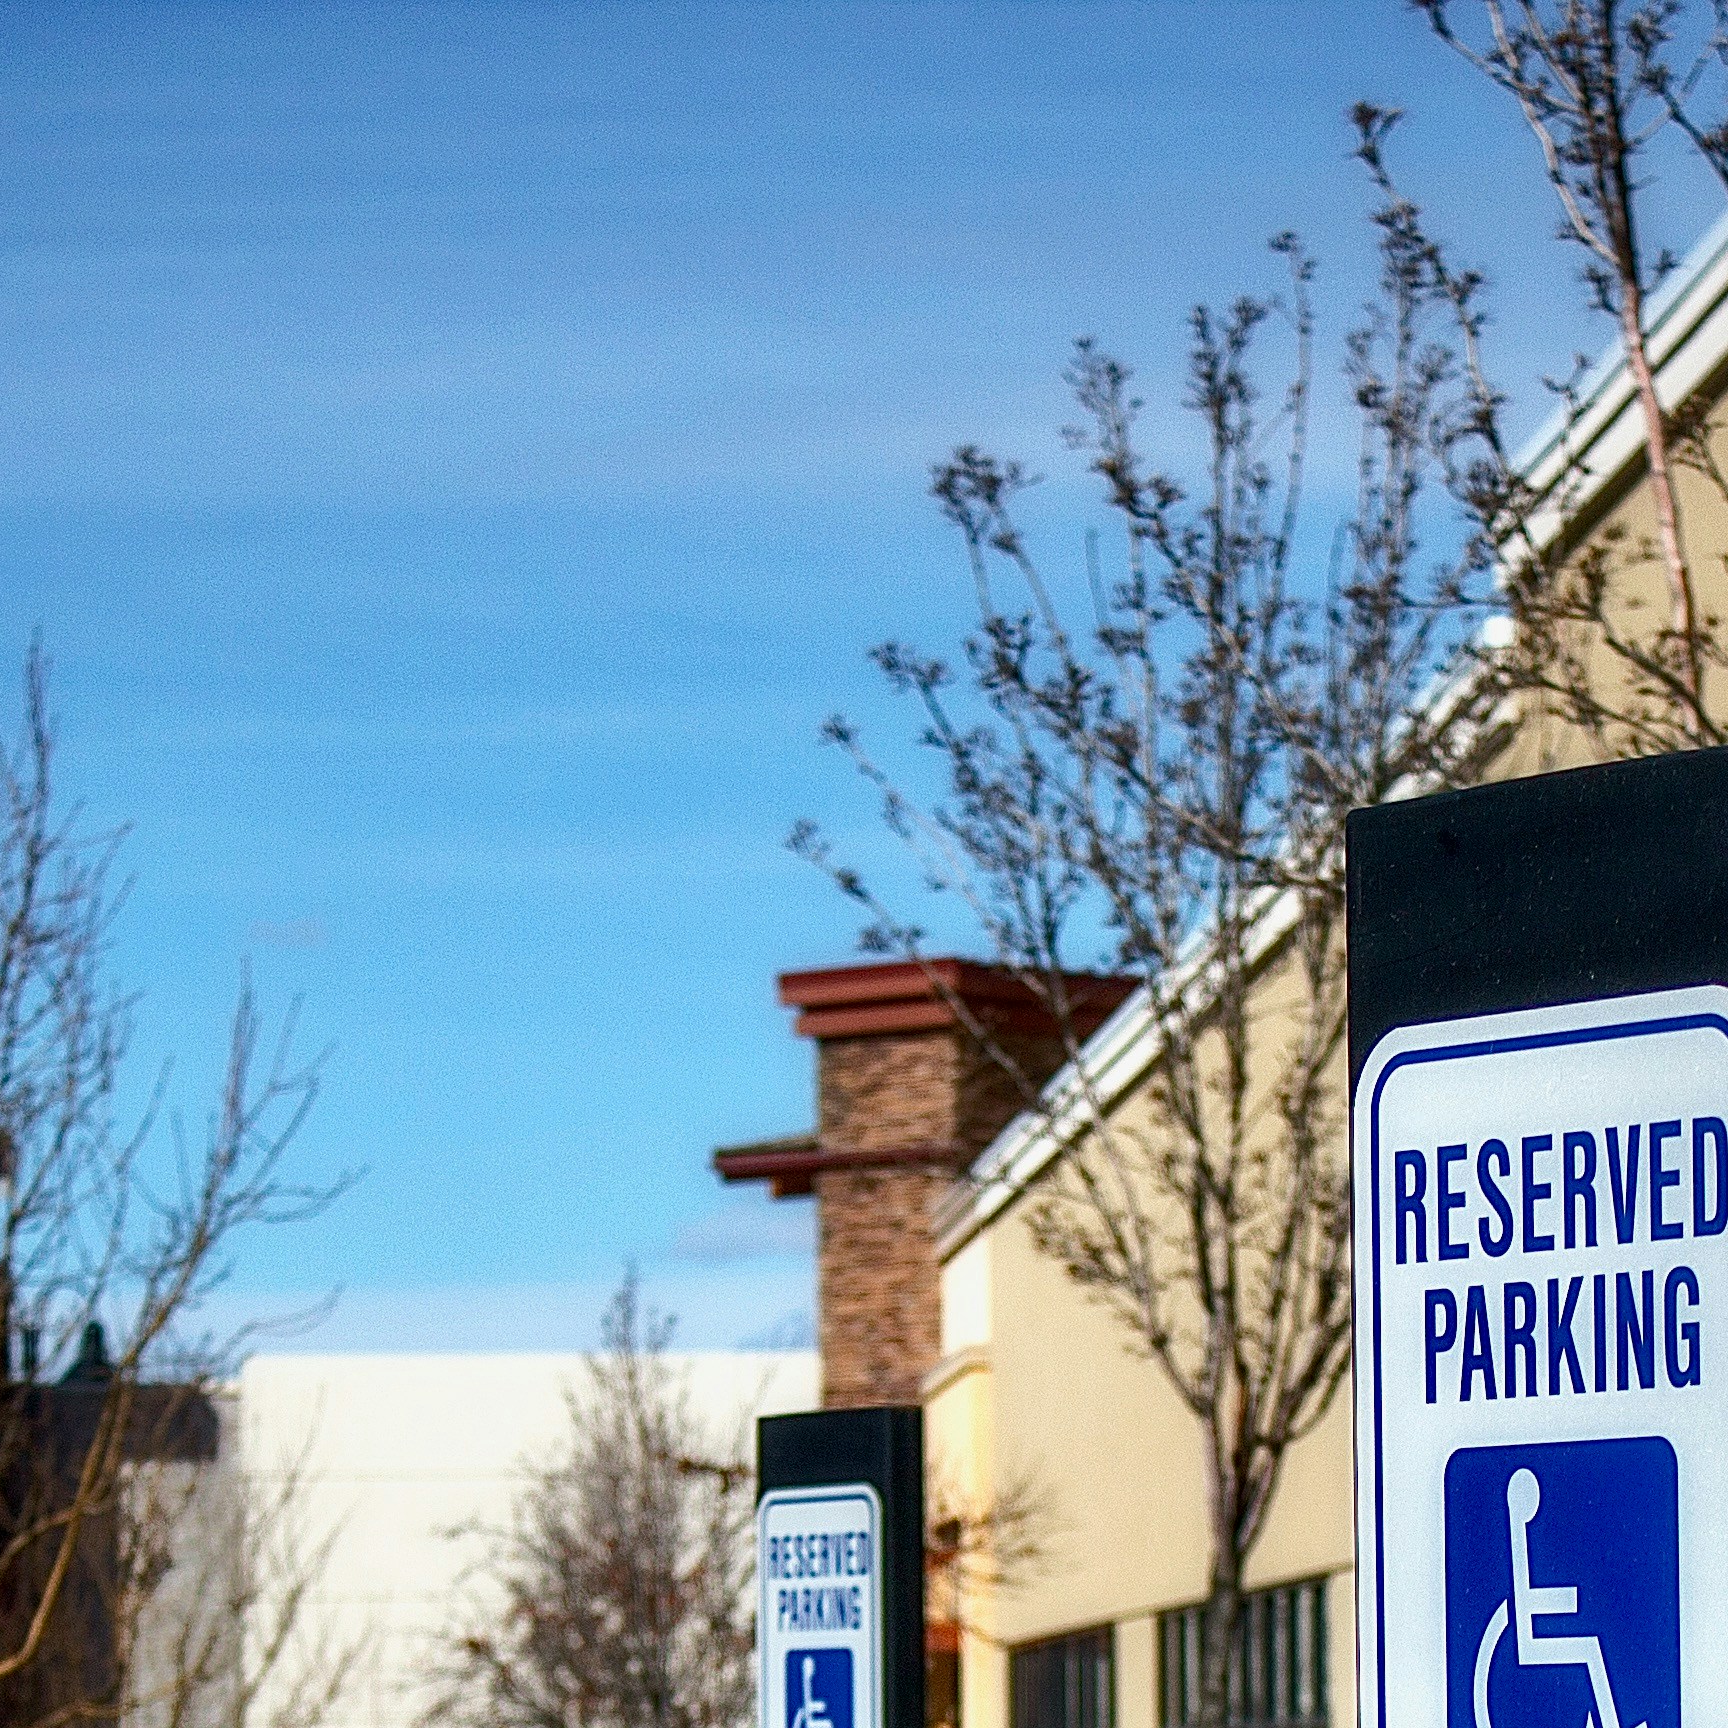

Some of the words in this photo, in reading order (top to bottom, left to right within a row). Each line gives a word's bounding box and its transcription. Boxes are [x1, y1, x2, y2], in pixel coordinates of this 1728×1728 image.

[1395, 1116, 1728, 1264] RESERVED
[1425, 1266, 1701, 1404] PARKING
[768, 1532, 873, 1578] RESERVED
[778, 1586, 861, 1632] PARKING
